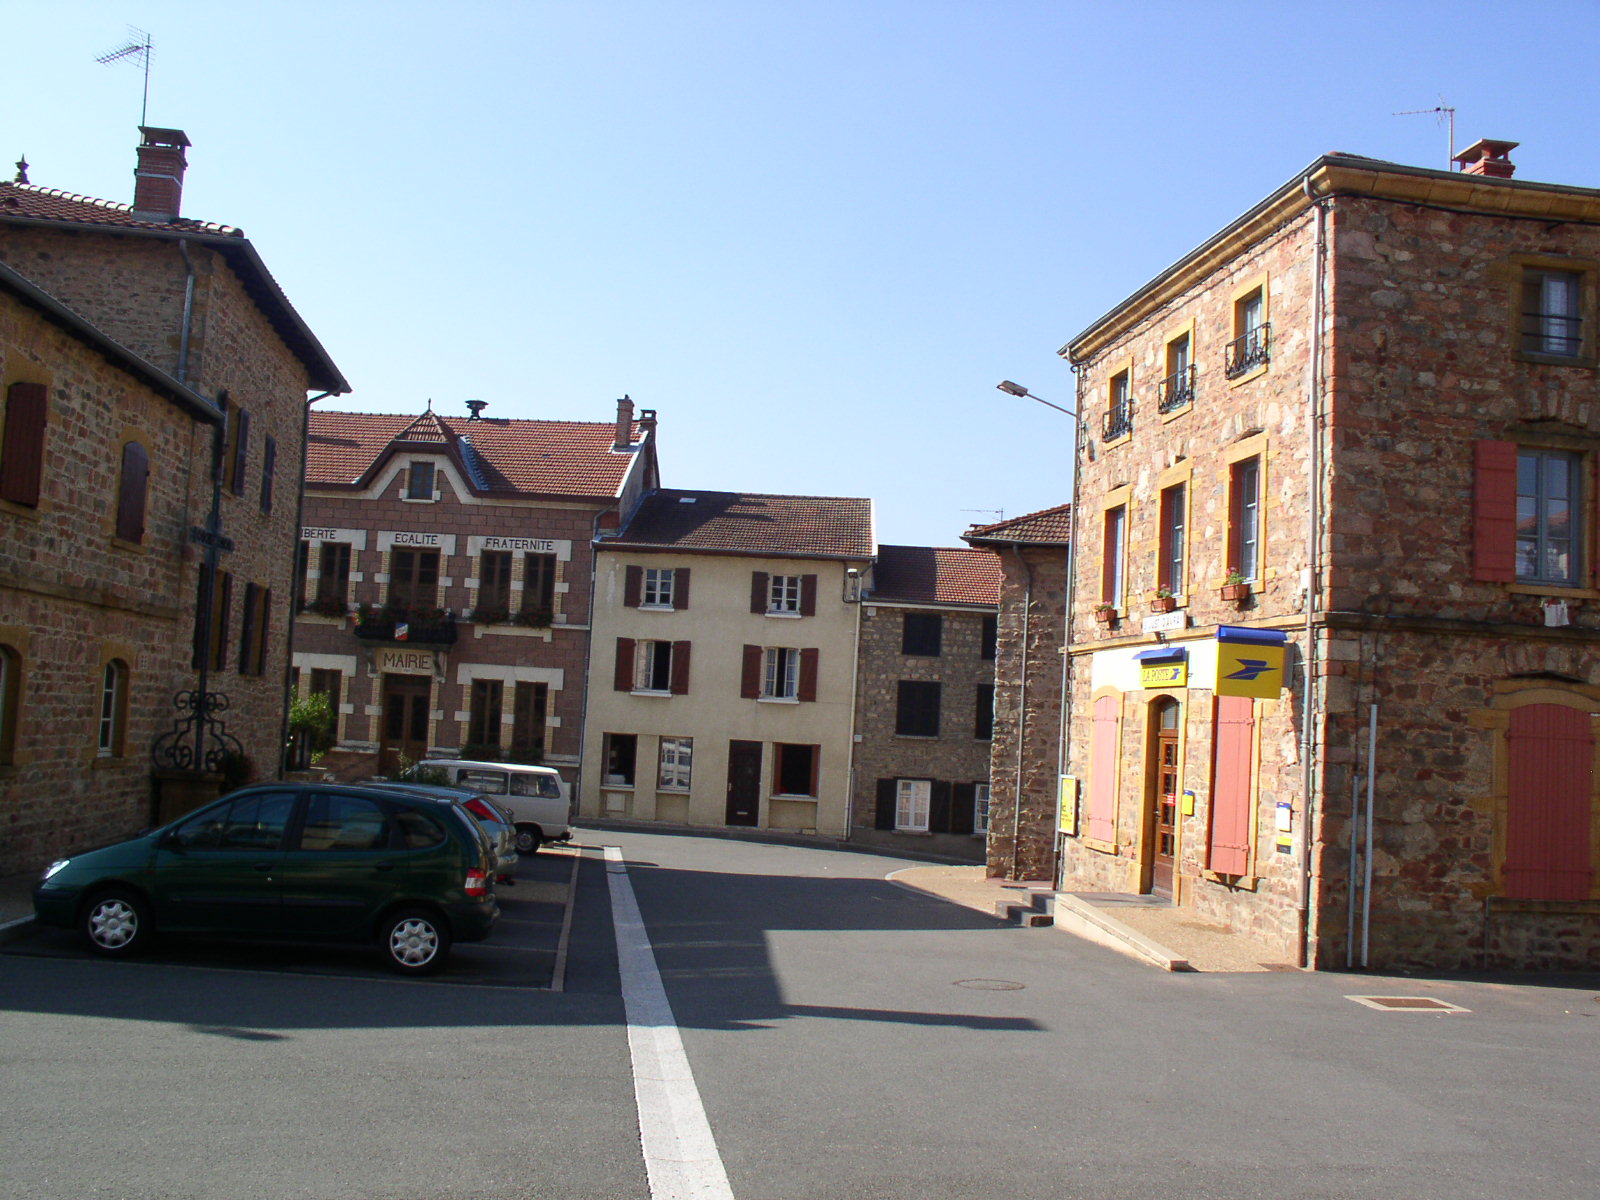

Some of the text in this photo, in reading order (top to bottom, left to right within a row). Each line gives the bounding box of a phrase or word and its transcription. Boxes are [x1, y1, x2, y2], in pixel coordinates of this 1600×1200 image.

[300, 528, 336, 540] IBERTE
[394, 533, 438, 545] EGALITE
[485, 538, 554, 550] FRATERNITE
[383, 652, 431, 670] MAIRIE
[1143, 669, 1169, 682] LA POSTE
